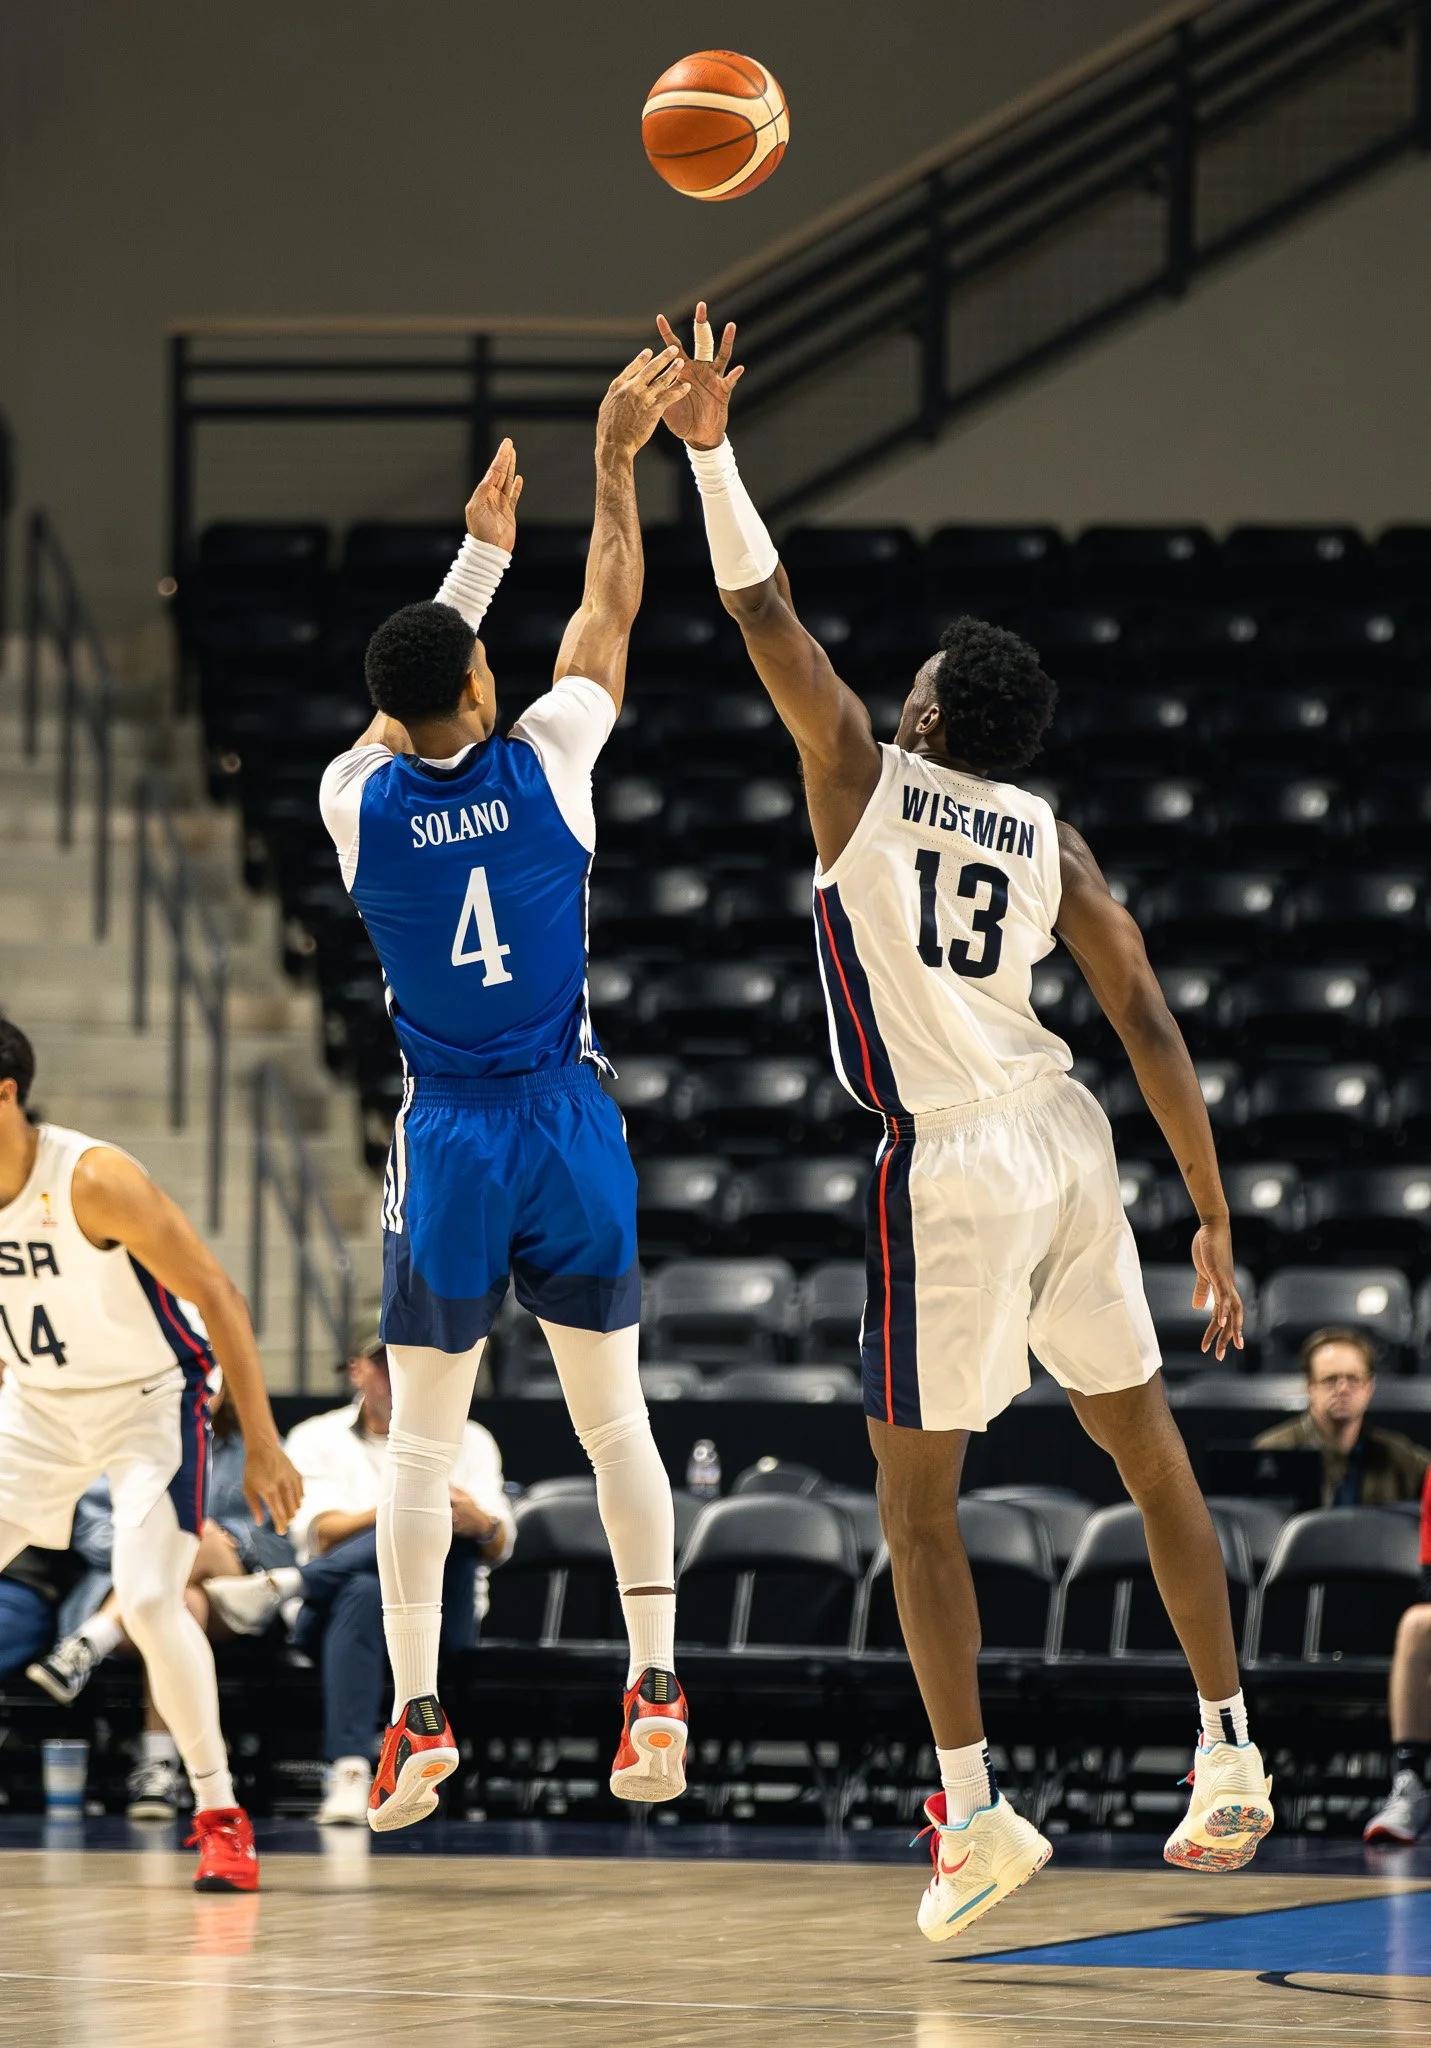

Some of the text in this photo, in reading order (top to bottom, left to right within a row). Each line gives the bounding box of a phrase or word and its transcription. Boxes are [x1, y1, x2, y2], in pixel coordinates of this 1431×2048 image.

[410, 799, 509, 849] SOLANO
[903, 785, 1035, 859] WISEMAN
[451, 866, 513, 987] 4
[914, 848, 1010, 979] 13
